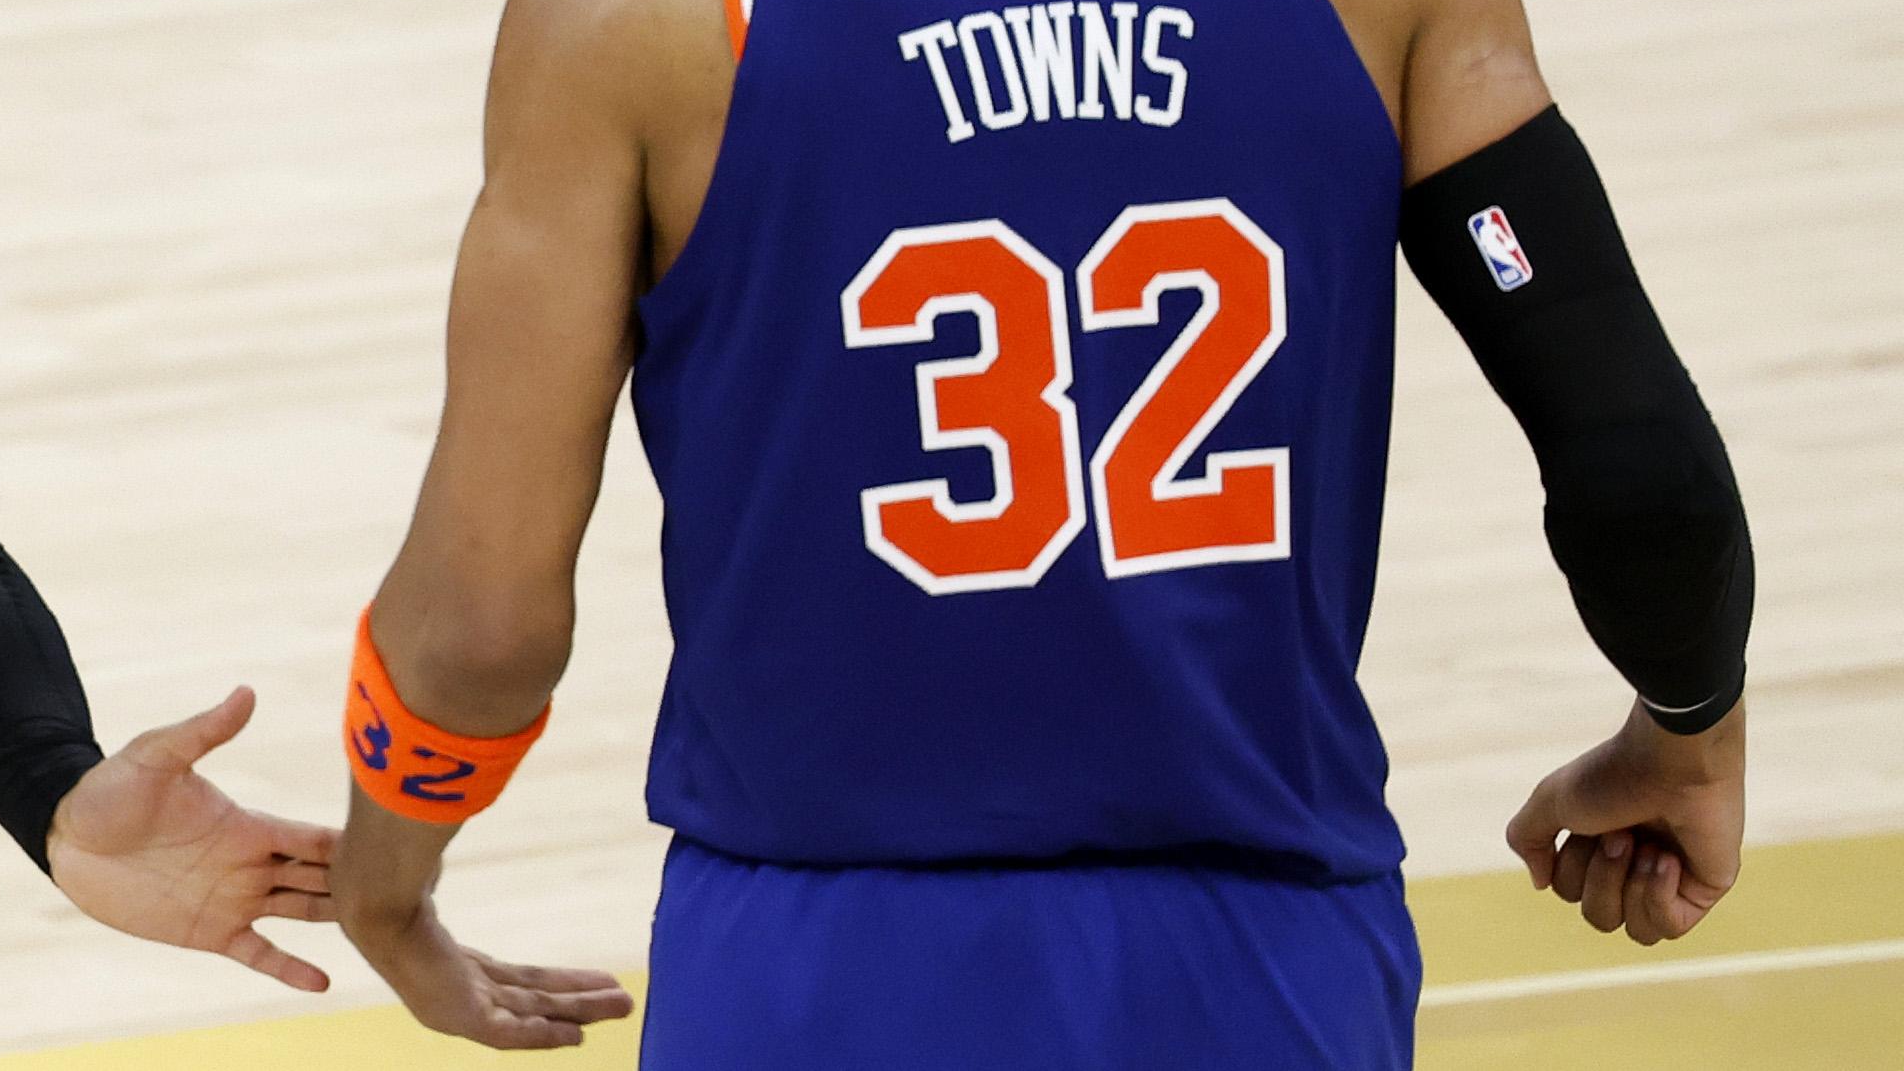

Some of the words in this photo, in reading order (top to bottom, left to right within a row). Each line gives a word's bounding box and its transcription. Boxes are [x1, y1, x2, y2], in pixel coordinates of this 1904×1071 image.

[898, 0, 1195, 144] TOWNS
[840, 196, 1291, 597] 32
[350, 681, 477, 802] 32
